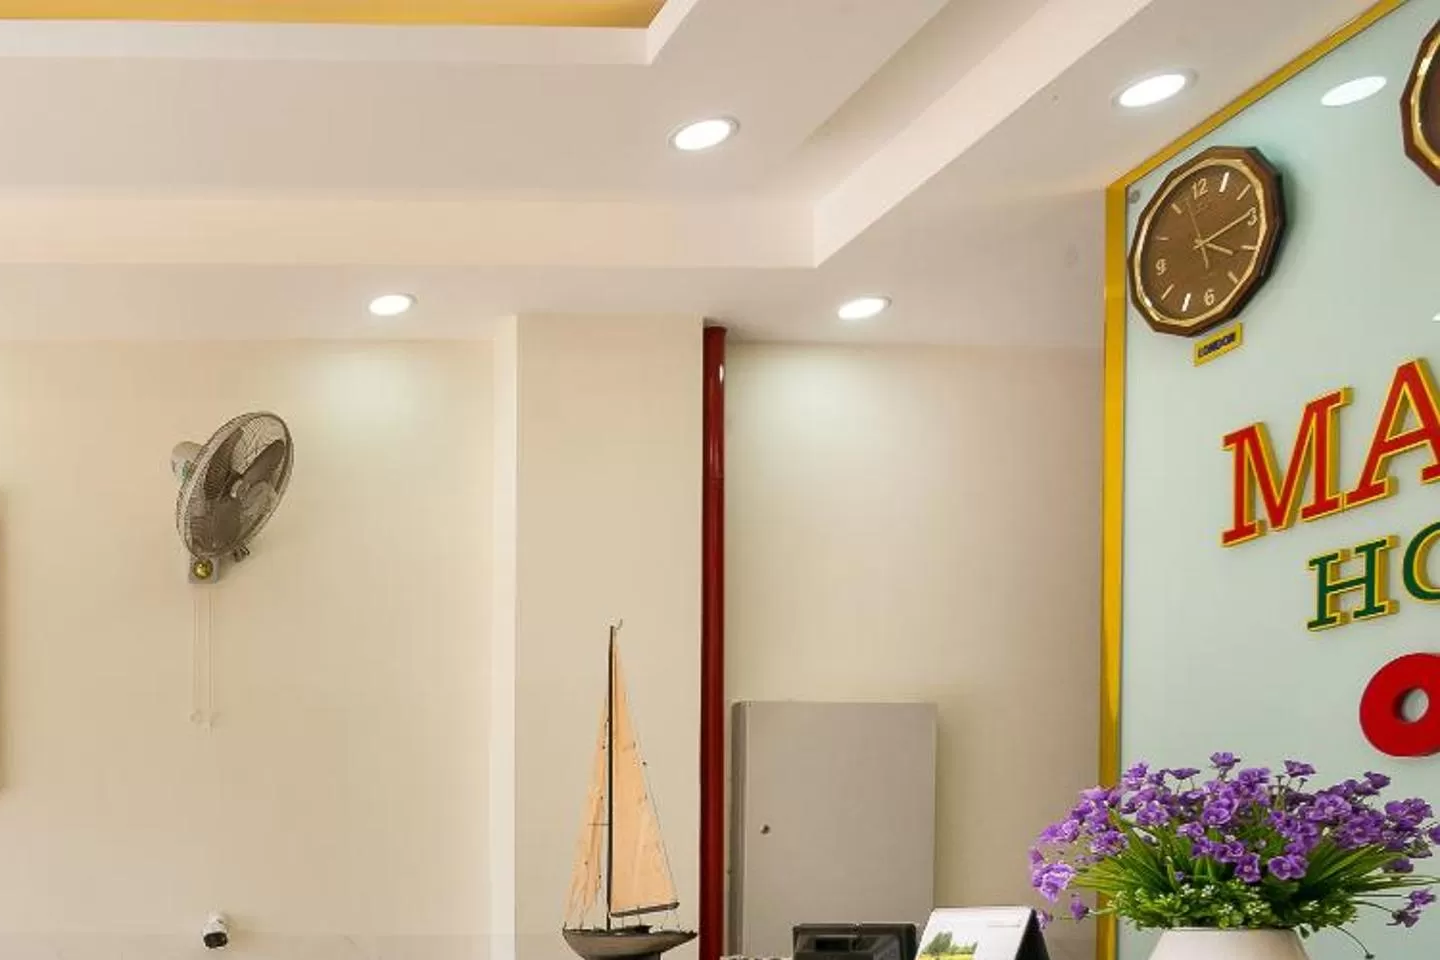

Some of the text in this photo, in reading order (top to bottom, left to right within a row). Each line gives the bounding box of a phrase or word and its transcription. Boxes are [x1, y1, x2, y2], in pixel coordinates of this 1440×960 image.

[1191, 177, 1209, 200] 12
[1247, 206, 1259, 227] 3
[1155, 258, 1168, 276] 9
[1203, 287, 1216, 307] 6
[1197, 331, 1236, 358] LONDON
